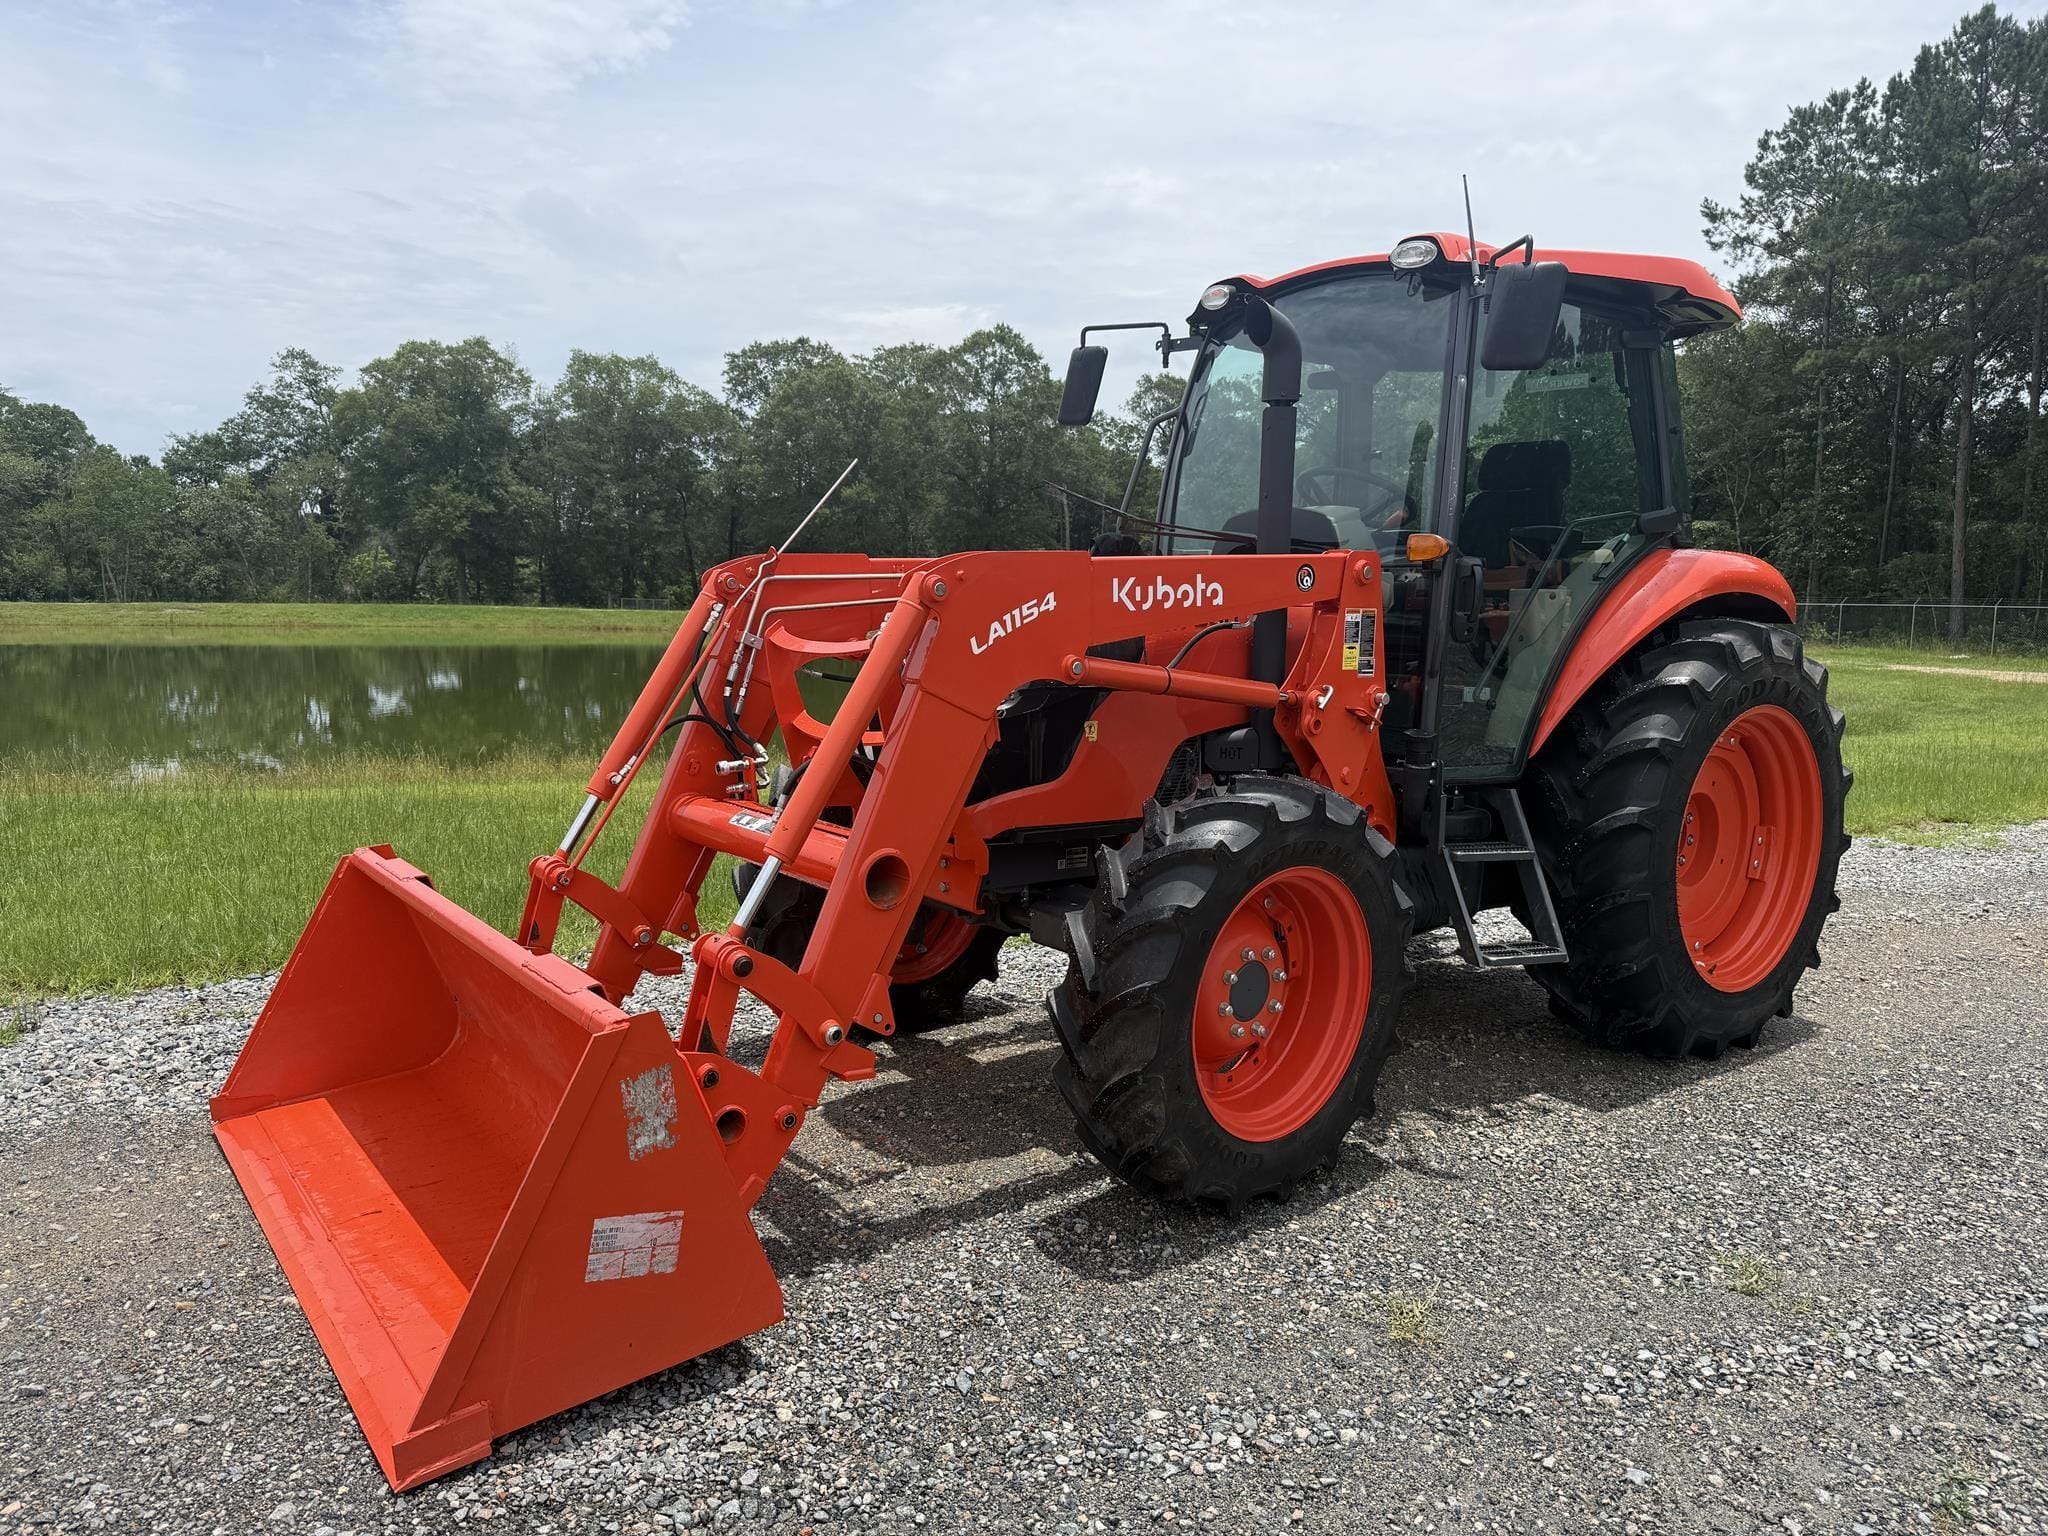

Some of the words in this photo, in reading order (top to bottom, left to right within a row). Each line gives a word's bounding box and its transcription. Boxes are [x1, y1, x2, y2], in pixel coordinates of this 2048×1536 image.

[1112, 573, 1224, 612] Kubota
[969, 591, 1057, 656] LA1154
[1219, 745, 1244, 761] HOT
